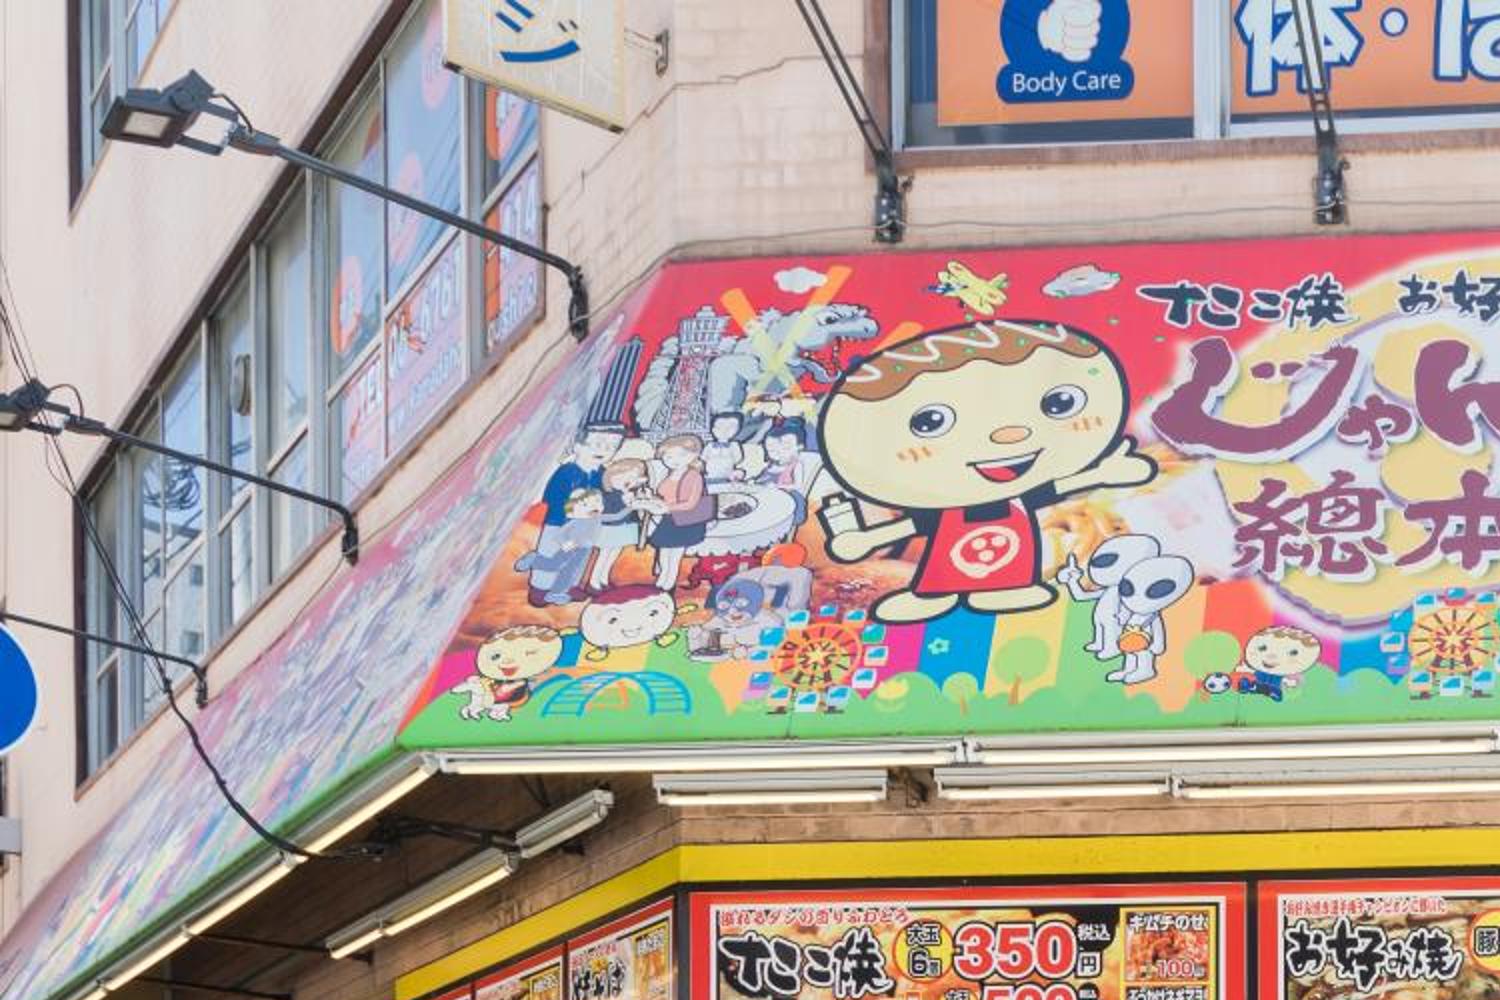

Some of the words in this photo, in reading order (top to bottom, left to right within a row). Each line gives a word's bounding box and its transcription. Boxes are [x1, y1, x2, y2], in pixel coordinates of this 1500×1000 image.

[1012, 73, 1066, 97] Body
[1073, 71, 1121, 93] Care
[1078, 922, 1111, 942] 税込
[1129, 912, 1208, 931] キムチのせ
[956, 922, 1075, 978] 350
[1286, 916, 1463, 992] お好み焼
[1078, 953, 1100, 976] 円
[1157, 959, 1195, 977] 100
